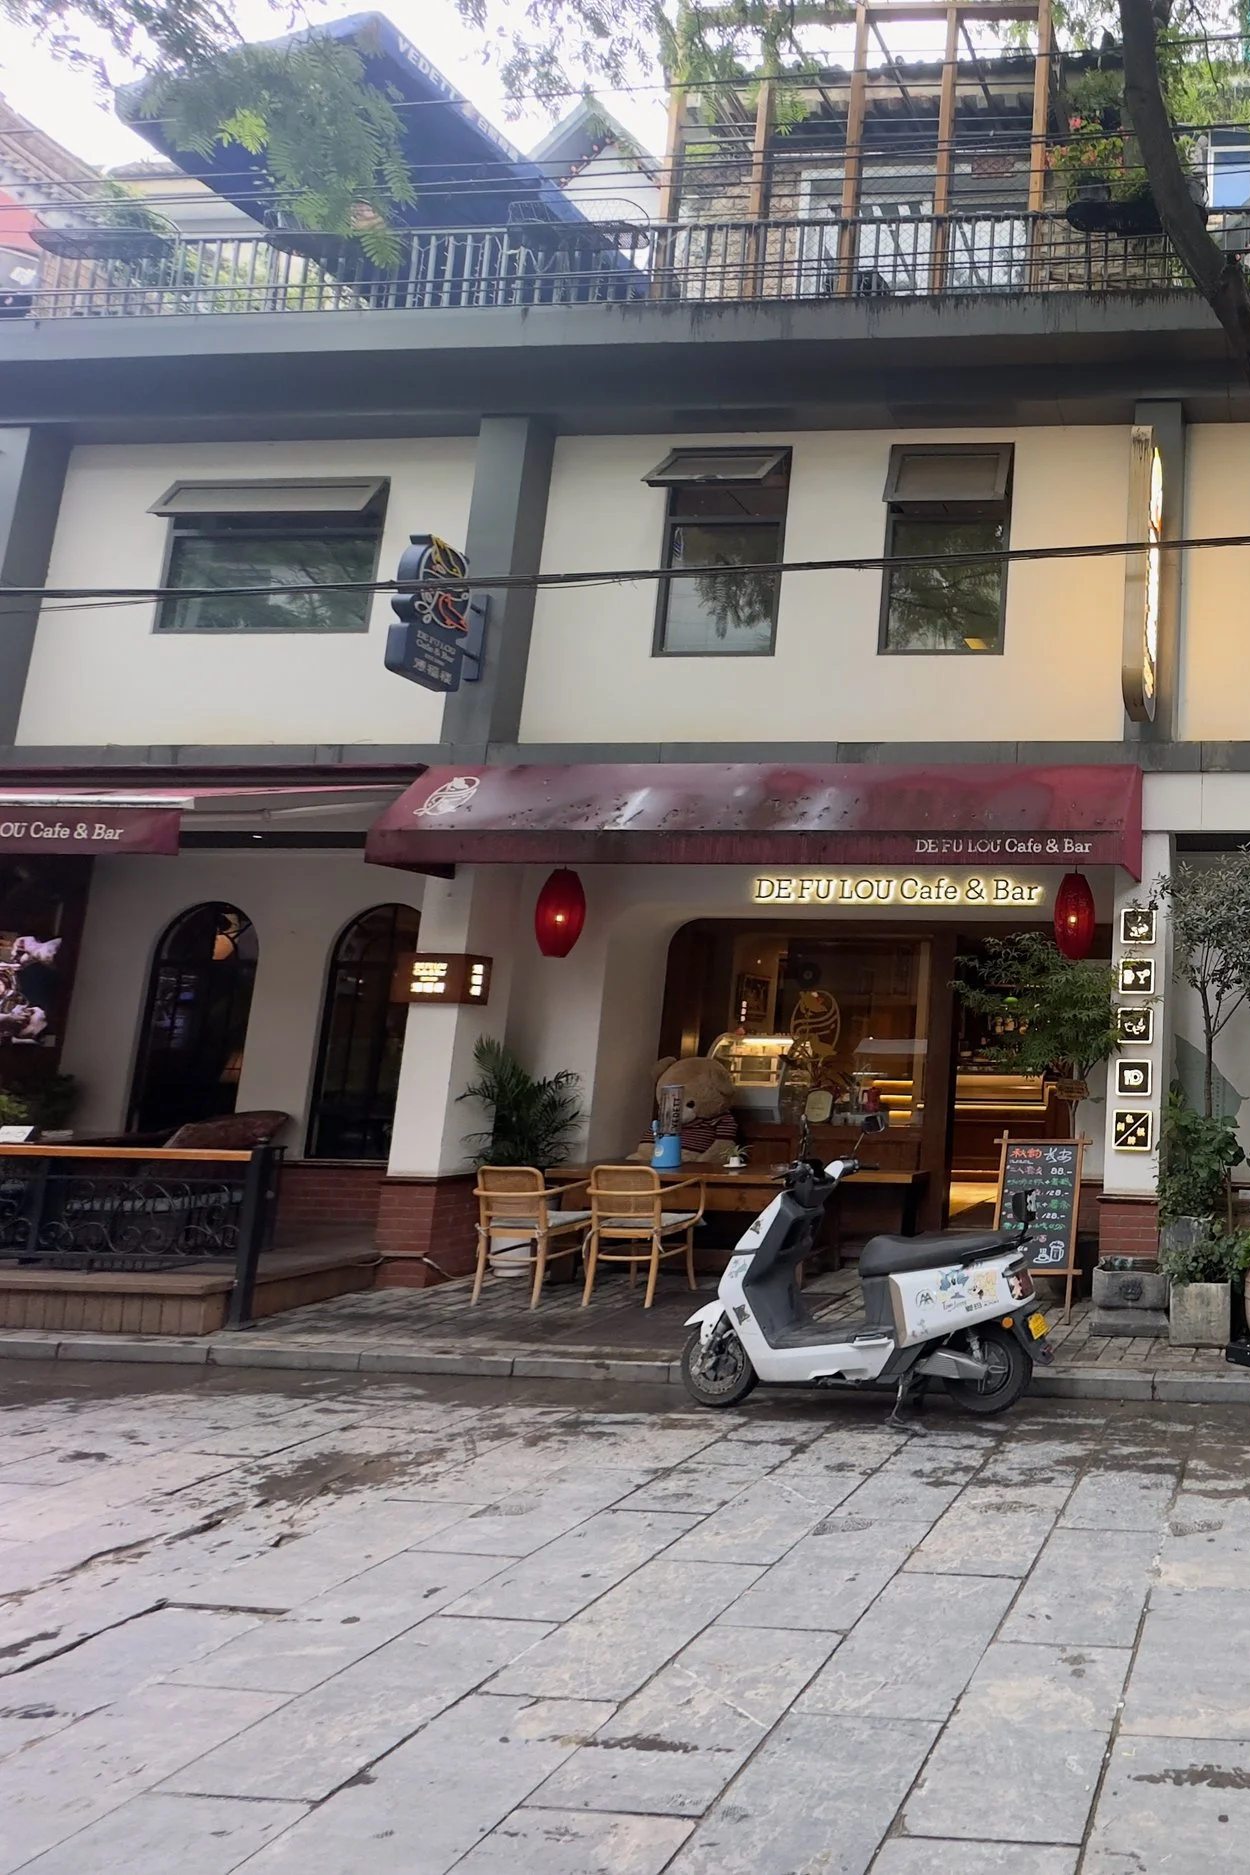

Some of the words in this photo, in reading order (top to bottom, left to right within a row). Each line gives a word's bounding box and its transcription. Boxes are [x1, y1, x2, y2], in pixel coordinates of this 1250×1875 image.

[30, 821, 70, 839] Cafe
[73, 823, 88, 839] &
[91, 824, 124, 840] Bar
[915, 840, 939, 853] DE
[942, 840, 963, 853] FU
[967, 840, 1002, 853] LOU
[1005, 839, 1042, 853] Cafe
[1046, 840, 1059, 853] &
[1063, 840, 1092, 853] Bar
[755, 878, 793, 899] DE
[798, 879, 834, 899] FU
[838, 878, 896, 900] LOU
[900, 877, 958, 901] Cafe
[965, 878, 985, 900] &
[993, 878, 1039, 901] Bar
